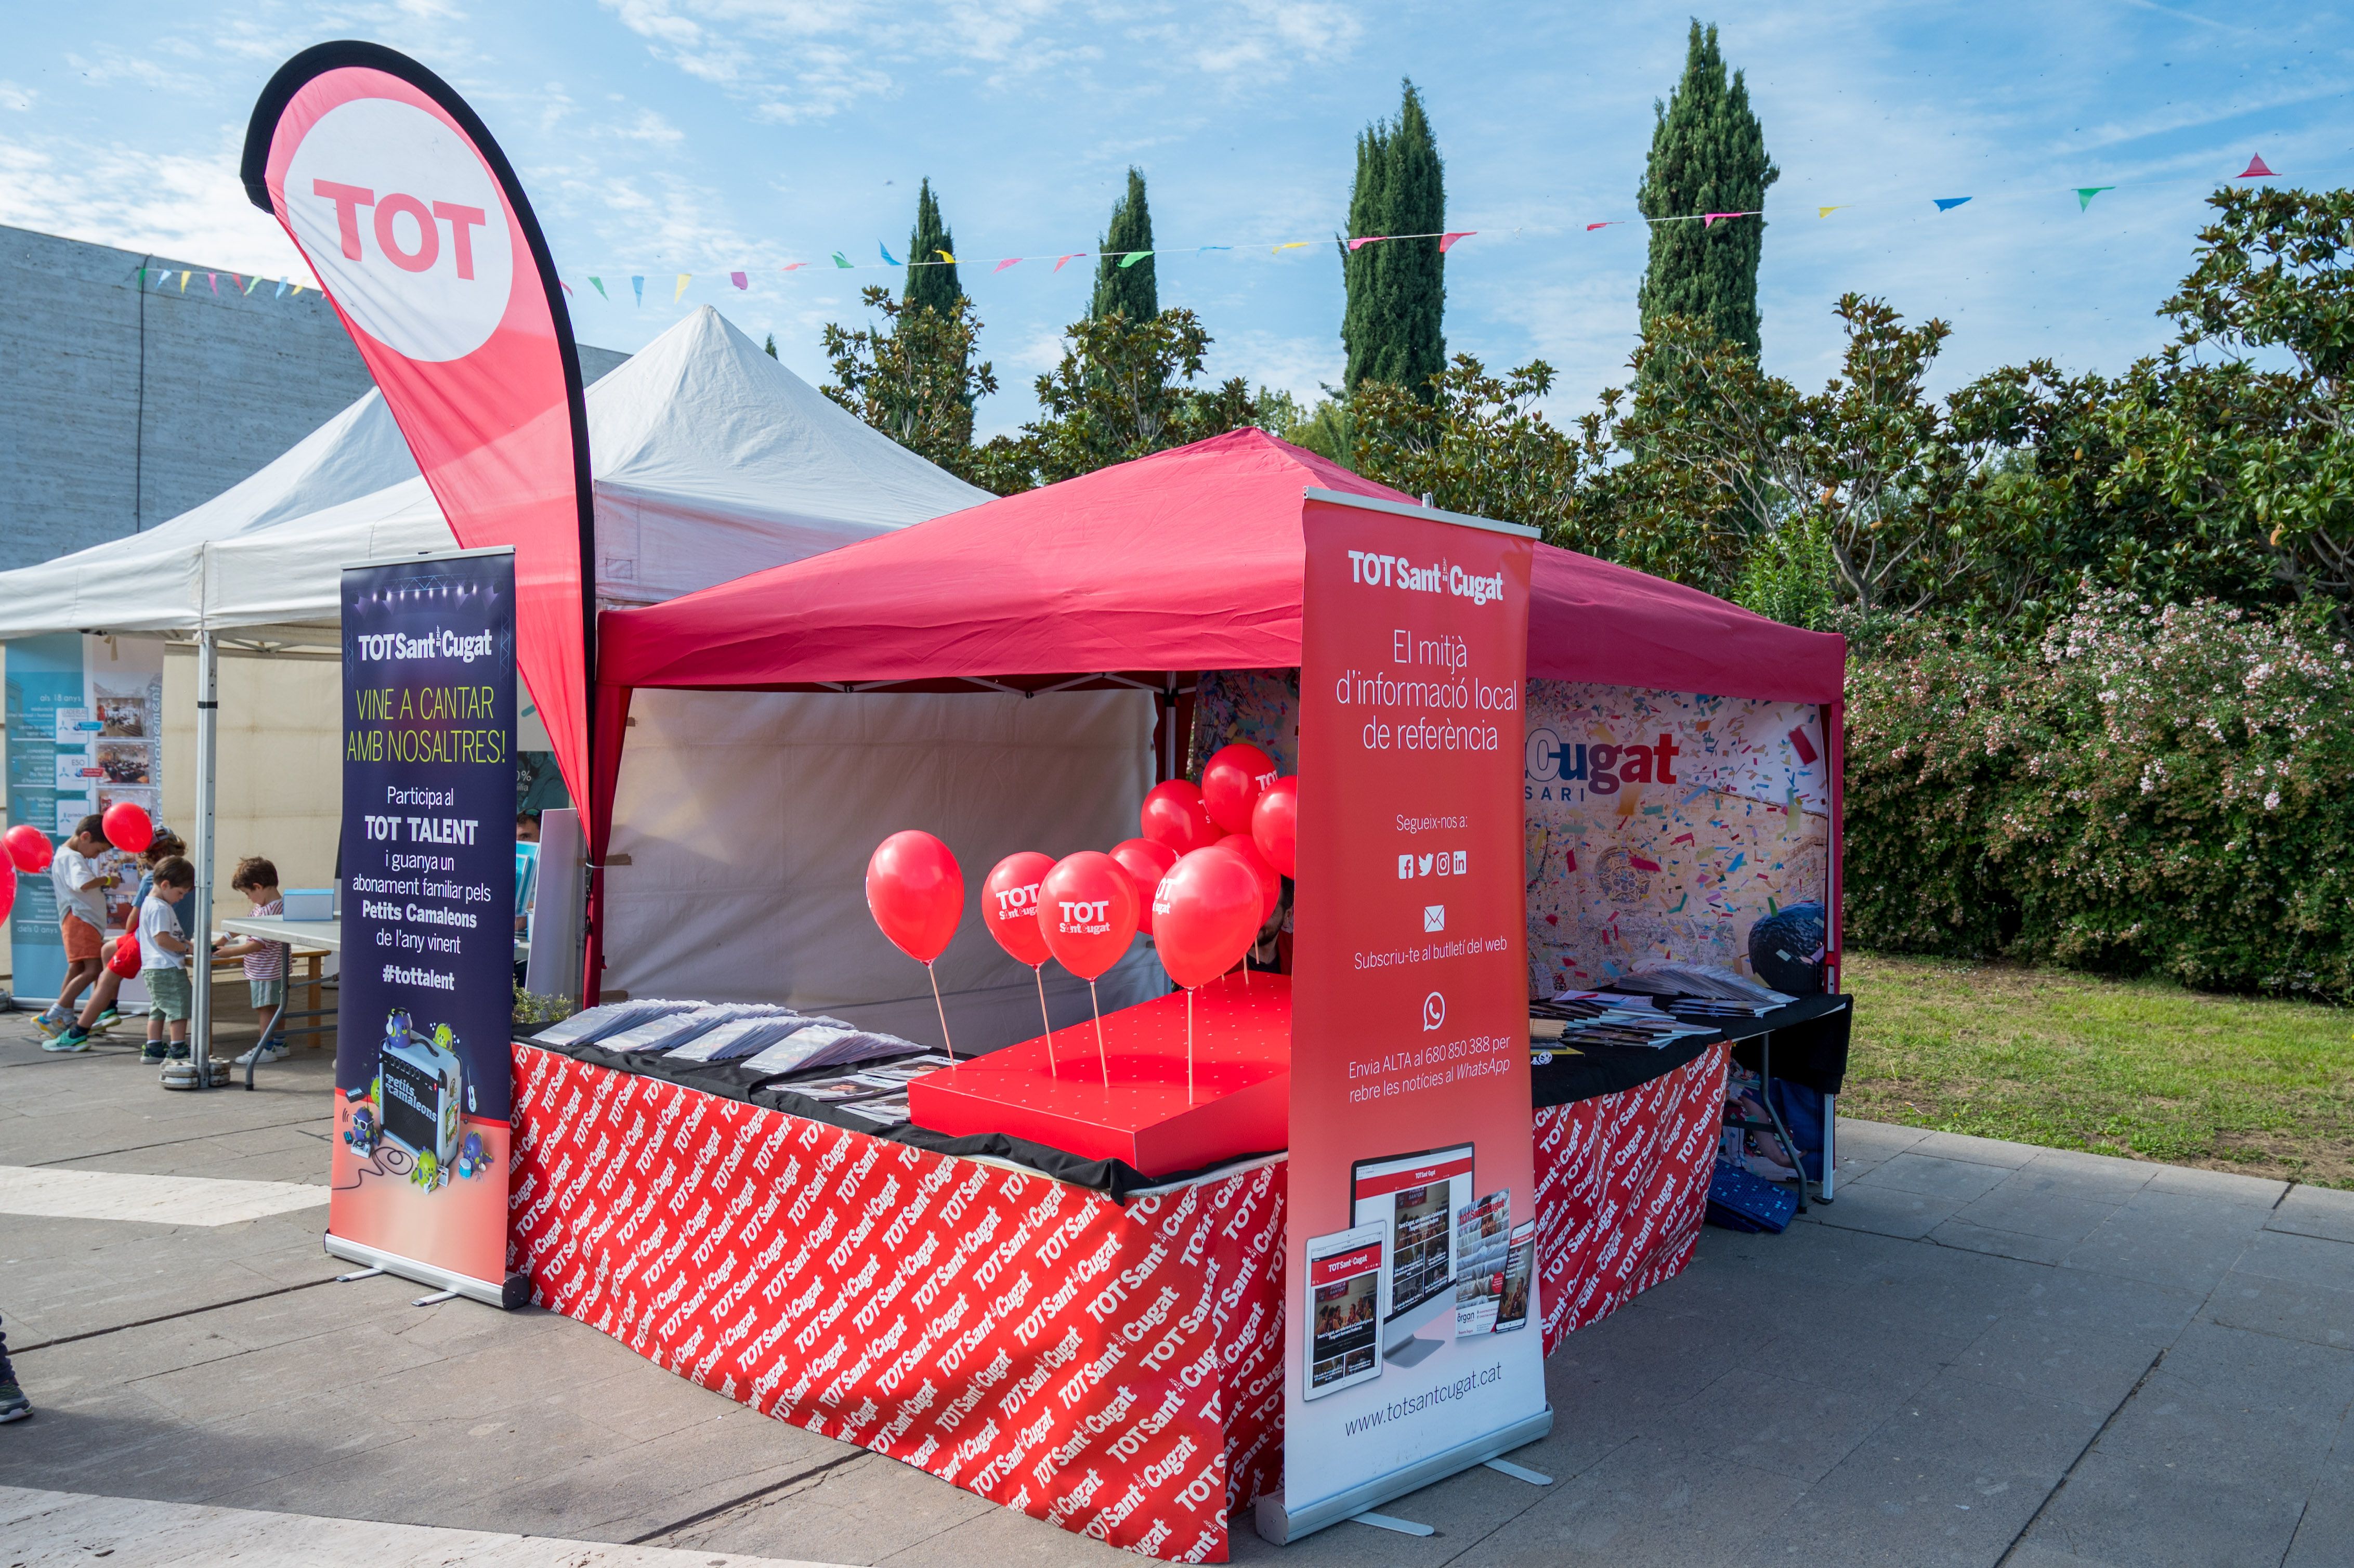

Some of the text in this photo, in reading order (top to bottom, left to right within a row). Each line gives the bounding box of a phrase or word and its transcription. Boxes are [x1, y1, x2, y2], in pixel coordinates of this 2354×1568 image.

[313, 178, 486, 280] TOT
[1394, 629, 1467, 674] El mitjà
[356, 686, 494, 720] VINE A CANTAR
[1476, 677, 1516, 710] local
[347, 730, 505, 763] AMB NOSALTRES!
[1363, 716, 1497, 750] de referència
[388, 786, 453, 809] Participa al
[365, 815, 478, 845] TOT TALENT
[1396, 814, 1468, 834] Segueix-nos a:
[386, 850, 454, 873] i guanya un
[353, 873, 491, 904] abonament familiar pels
[996, 883, 1039, 910] TOT
[362, 900, 477, 928] Petits Camaleons
[1059, 900, 1109, 922] TOT
[376, 928, 460, 953] de l'any vinent
[1355, 936, 1507, 970] Subscriu-te al butlletí del web
[383, 964, 454, 990] #tottalent
[1350, 1036, 1510, 1079] Envia ALTA al 680 850 388 per
[386, 1074, 414, 1097] Petits
[1350, 1059, 1510, 1103] rebre les notícies al WhatsApp
[385, 1082, 437, 1122] Camaleons
[1345, 1361, 1501, 1436] www.totsantcugat.cat
